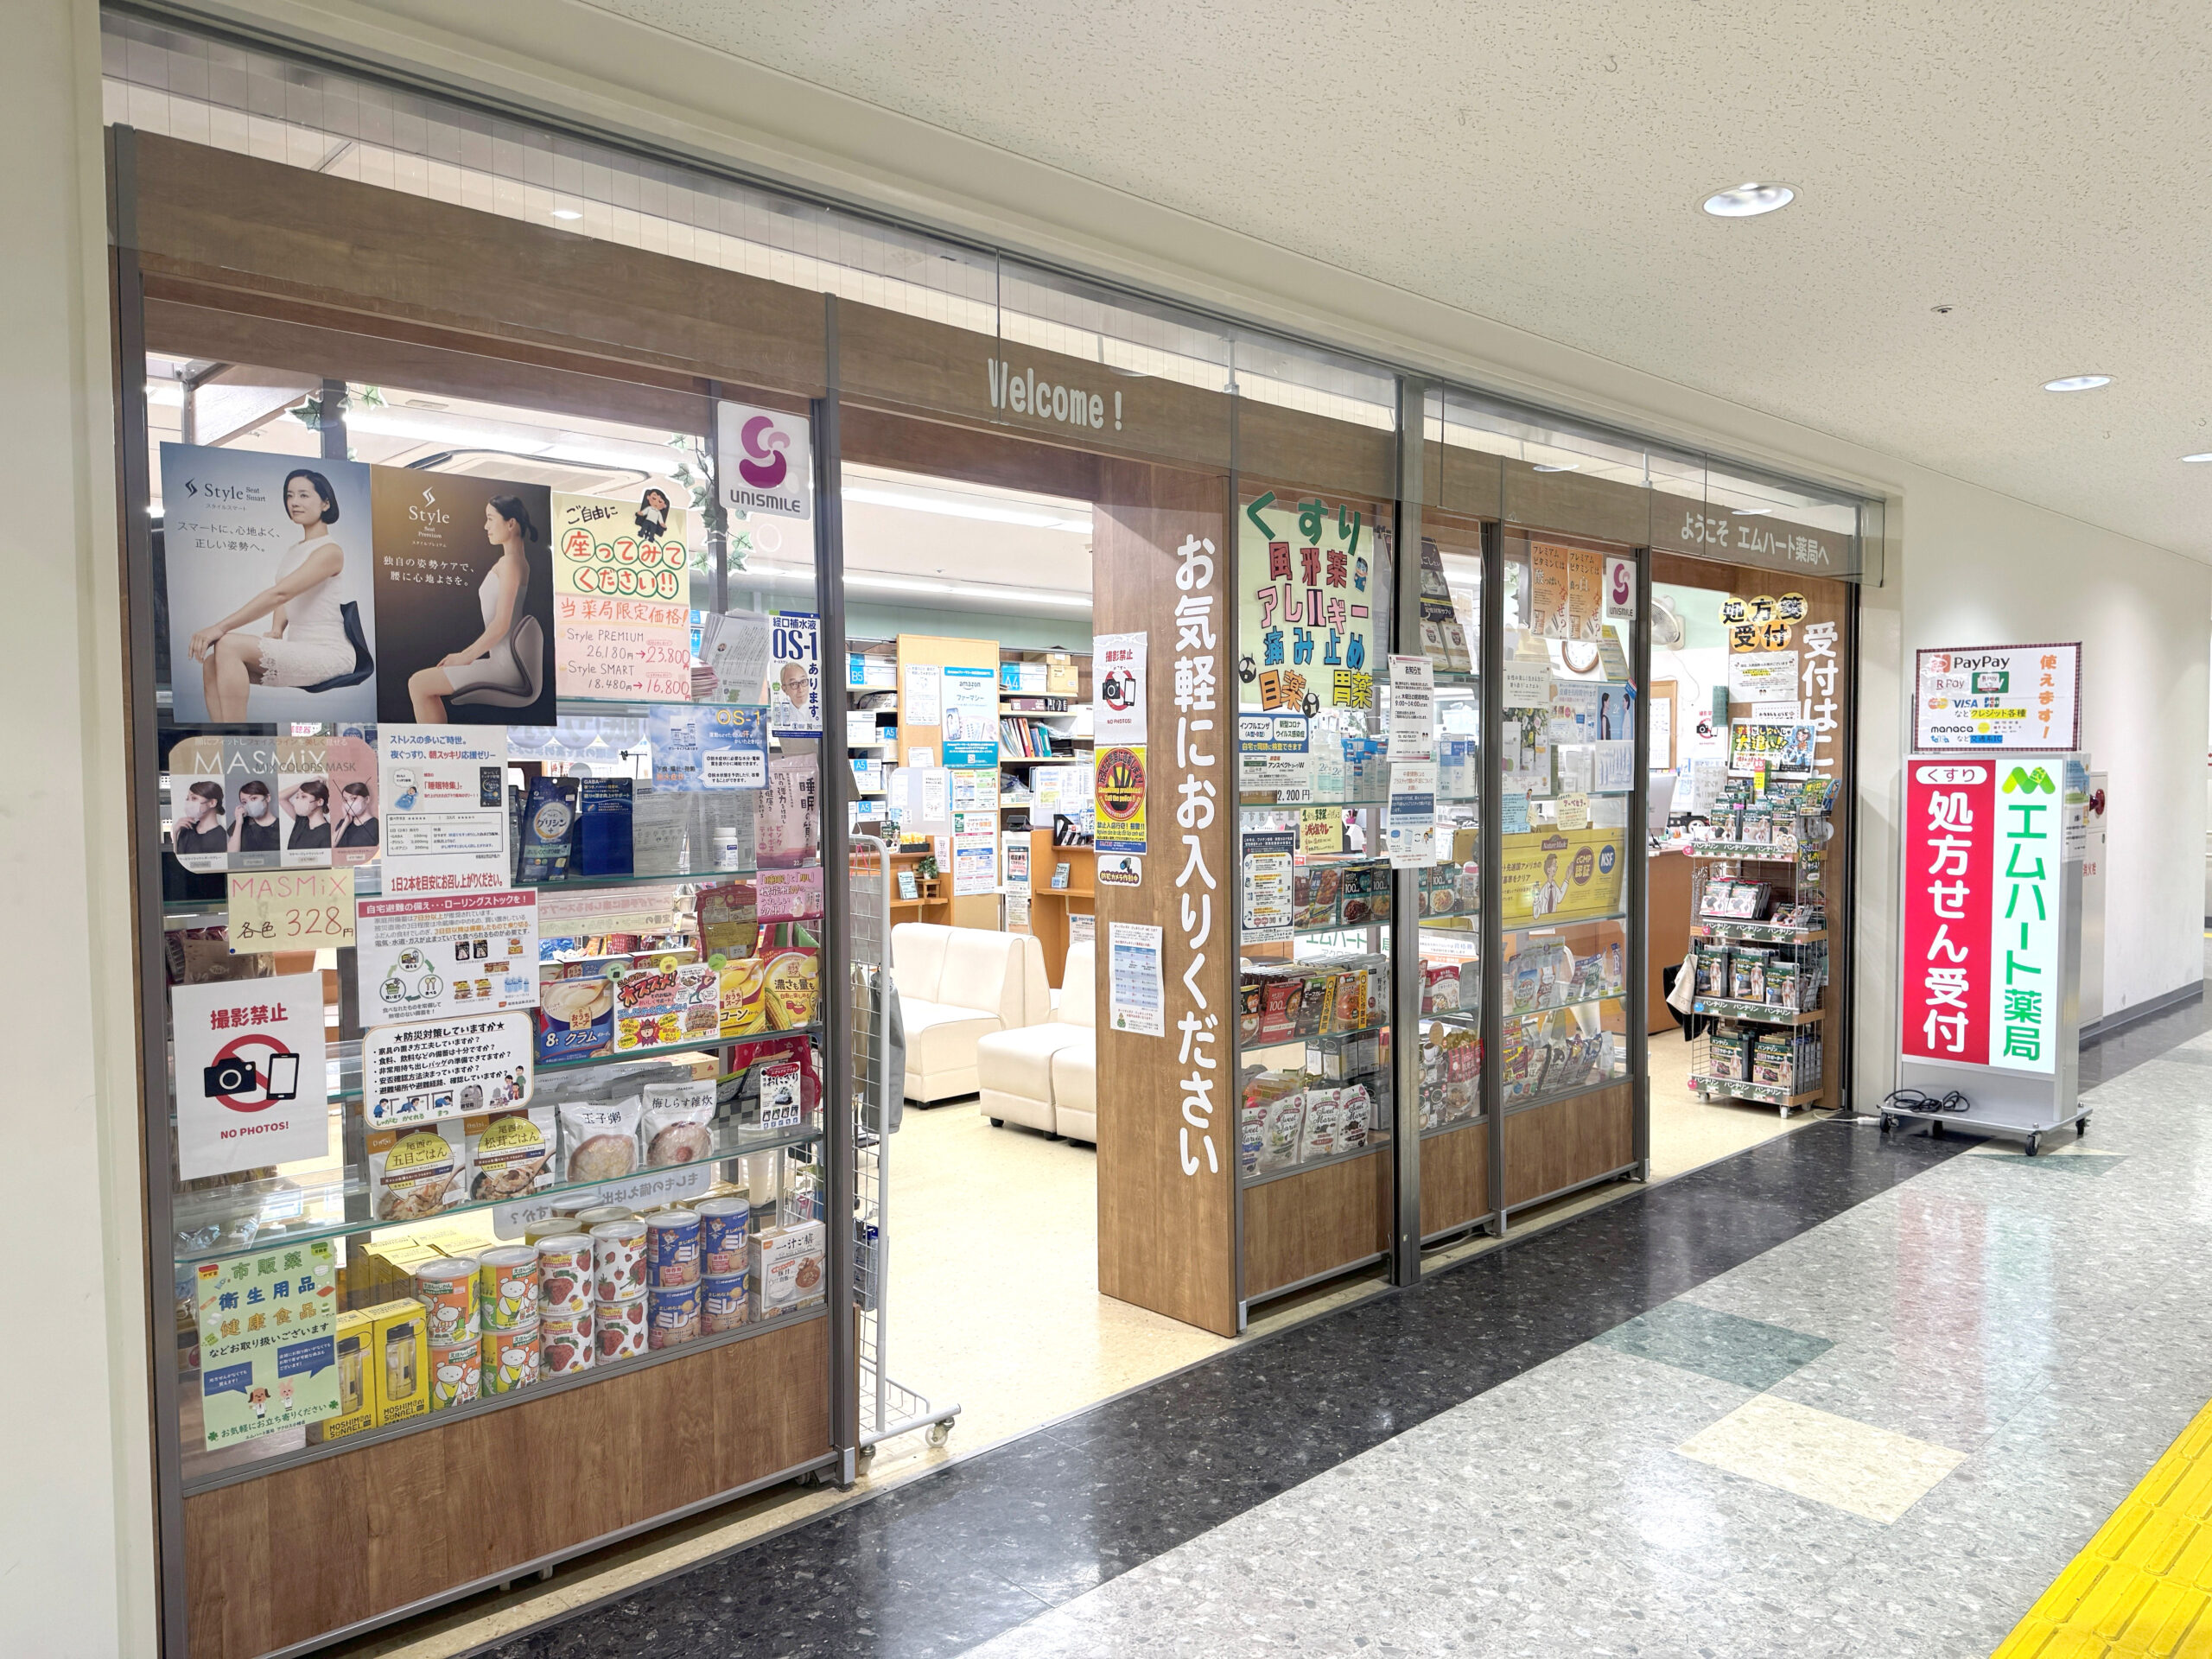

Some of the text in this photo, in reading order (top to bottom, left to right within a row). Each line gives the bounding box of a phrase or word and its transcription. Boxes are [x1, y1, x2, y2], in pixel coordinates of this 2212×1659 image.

[988, 358, 1122, 430] Welcome !
[204, 482, 244, 501] Style
[246, 493, 266, 502] Smart
[730, 489, 800, 513] UNISMILE
[409, 505, 450, 525] Style
[566, 505, 618, 524] ご自由に
[178, 521, 281, 539] スマートに、心地よく、
[1247, 491, 1362, 556] くすり
[195, 539, 266, 553] 正しい姿勢へ。
[1681, 512, 1829, 565] ようこそ エムハート薬局へ
[568, 531, 682, 570] 座ってみて
[383, 556, 474, 573] 独自の姿勢ケアで、
[1269, 542, 1347, 588] 風邪薬
[391, 571, 469, 587] 腰に心地よさを。
[1257, 583, 1369, 635] アレルギー
[1610, 607, 1633, 617] UNISMILE
[1722, 595, 1804, 623] 処方箋
[773, 617, 817, 629] 経口補水液
[567, 629, 644, 643] Style PREMIUM
[1734, 623, 1787, 647] 受付
[773, 628, 817, 661] OS-1
[1263, 626, 1364, 671] 痛み止め
[1106, 650, 1133, 662] 撮影禁止
[1954, 656, 2010, 670] PayPay
[568, 662, 634, 676] Style SMART
[851, 671, 863, 683] B5
[1004, 676, 1020, 690] A4
[1259, 670, 1373, 712] 目薬 胃薬
[808, 663, 820, 721] あります。
[2038, 655, 2056, 739] 使えます！
[1954, 699, 1978, 708] VISA
[716, 709, 760, 725] OS-1
[1955, 709, 2025, 718] などクレジット各種
[390, 734, 467, 746] ストレスの多いご時世。
[886, 728, 895, 736] A5
[391, 751, 495, 760] 夜ぐっすり、朝スッキリ応援ゼリー
[279, 762, 322, 772] COLORS
[327, 762, 356, 772] MASK
[855, 760, 866, 769] A5
[1928, 768, 1975, 782] くすり
[861, 802, 870, 811] A5
[1174, 533, 1218, 1177] お気軽にお入りください
[1576, 855, 1592, 863] cGMP
[1601, 853, 1613, 866] NSF
[232, 875, 346, 898] MASMiX
[391, 873, 503, 892] 1日2本を目安にお召し上がりください。
[1923, 790, 1974, 1052] 処方せん受付
[238, 922, 276, 938] 各色
[2003, 804, 2048, 1062] エムハート薬局
[774, 979, 815, 990] 濃さも量も
[211, 1002, 288, 1030] 撮影禁止
[720, 1008, 747, 1021] コーン
[564, 1031, 597, 1046] クラム
[652, 1096, 713, 1109] 梅しらす雑炊
[583, 1112, 621, 1124] 玉子粥
[220, 1122, 289, 1140] NO PHOTOS!
[499, 1124, 523, 1134] 尾西の
[485, 1132, 539, 1149] 松茸ごはん
[393, 1149, 447, 1166] 五目ごはん
[232, 1250, 302, 1280] 市販薬
[219, 1275, 315, 1311] 衛生用品
[220, 1301, 317, 1338] 健康食品
[209, 1322, 329, 1357] などお取り扱いございます
[221, 1404, 327, 1438] お気軽にお立ち寄りください
